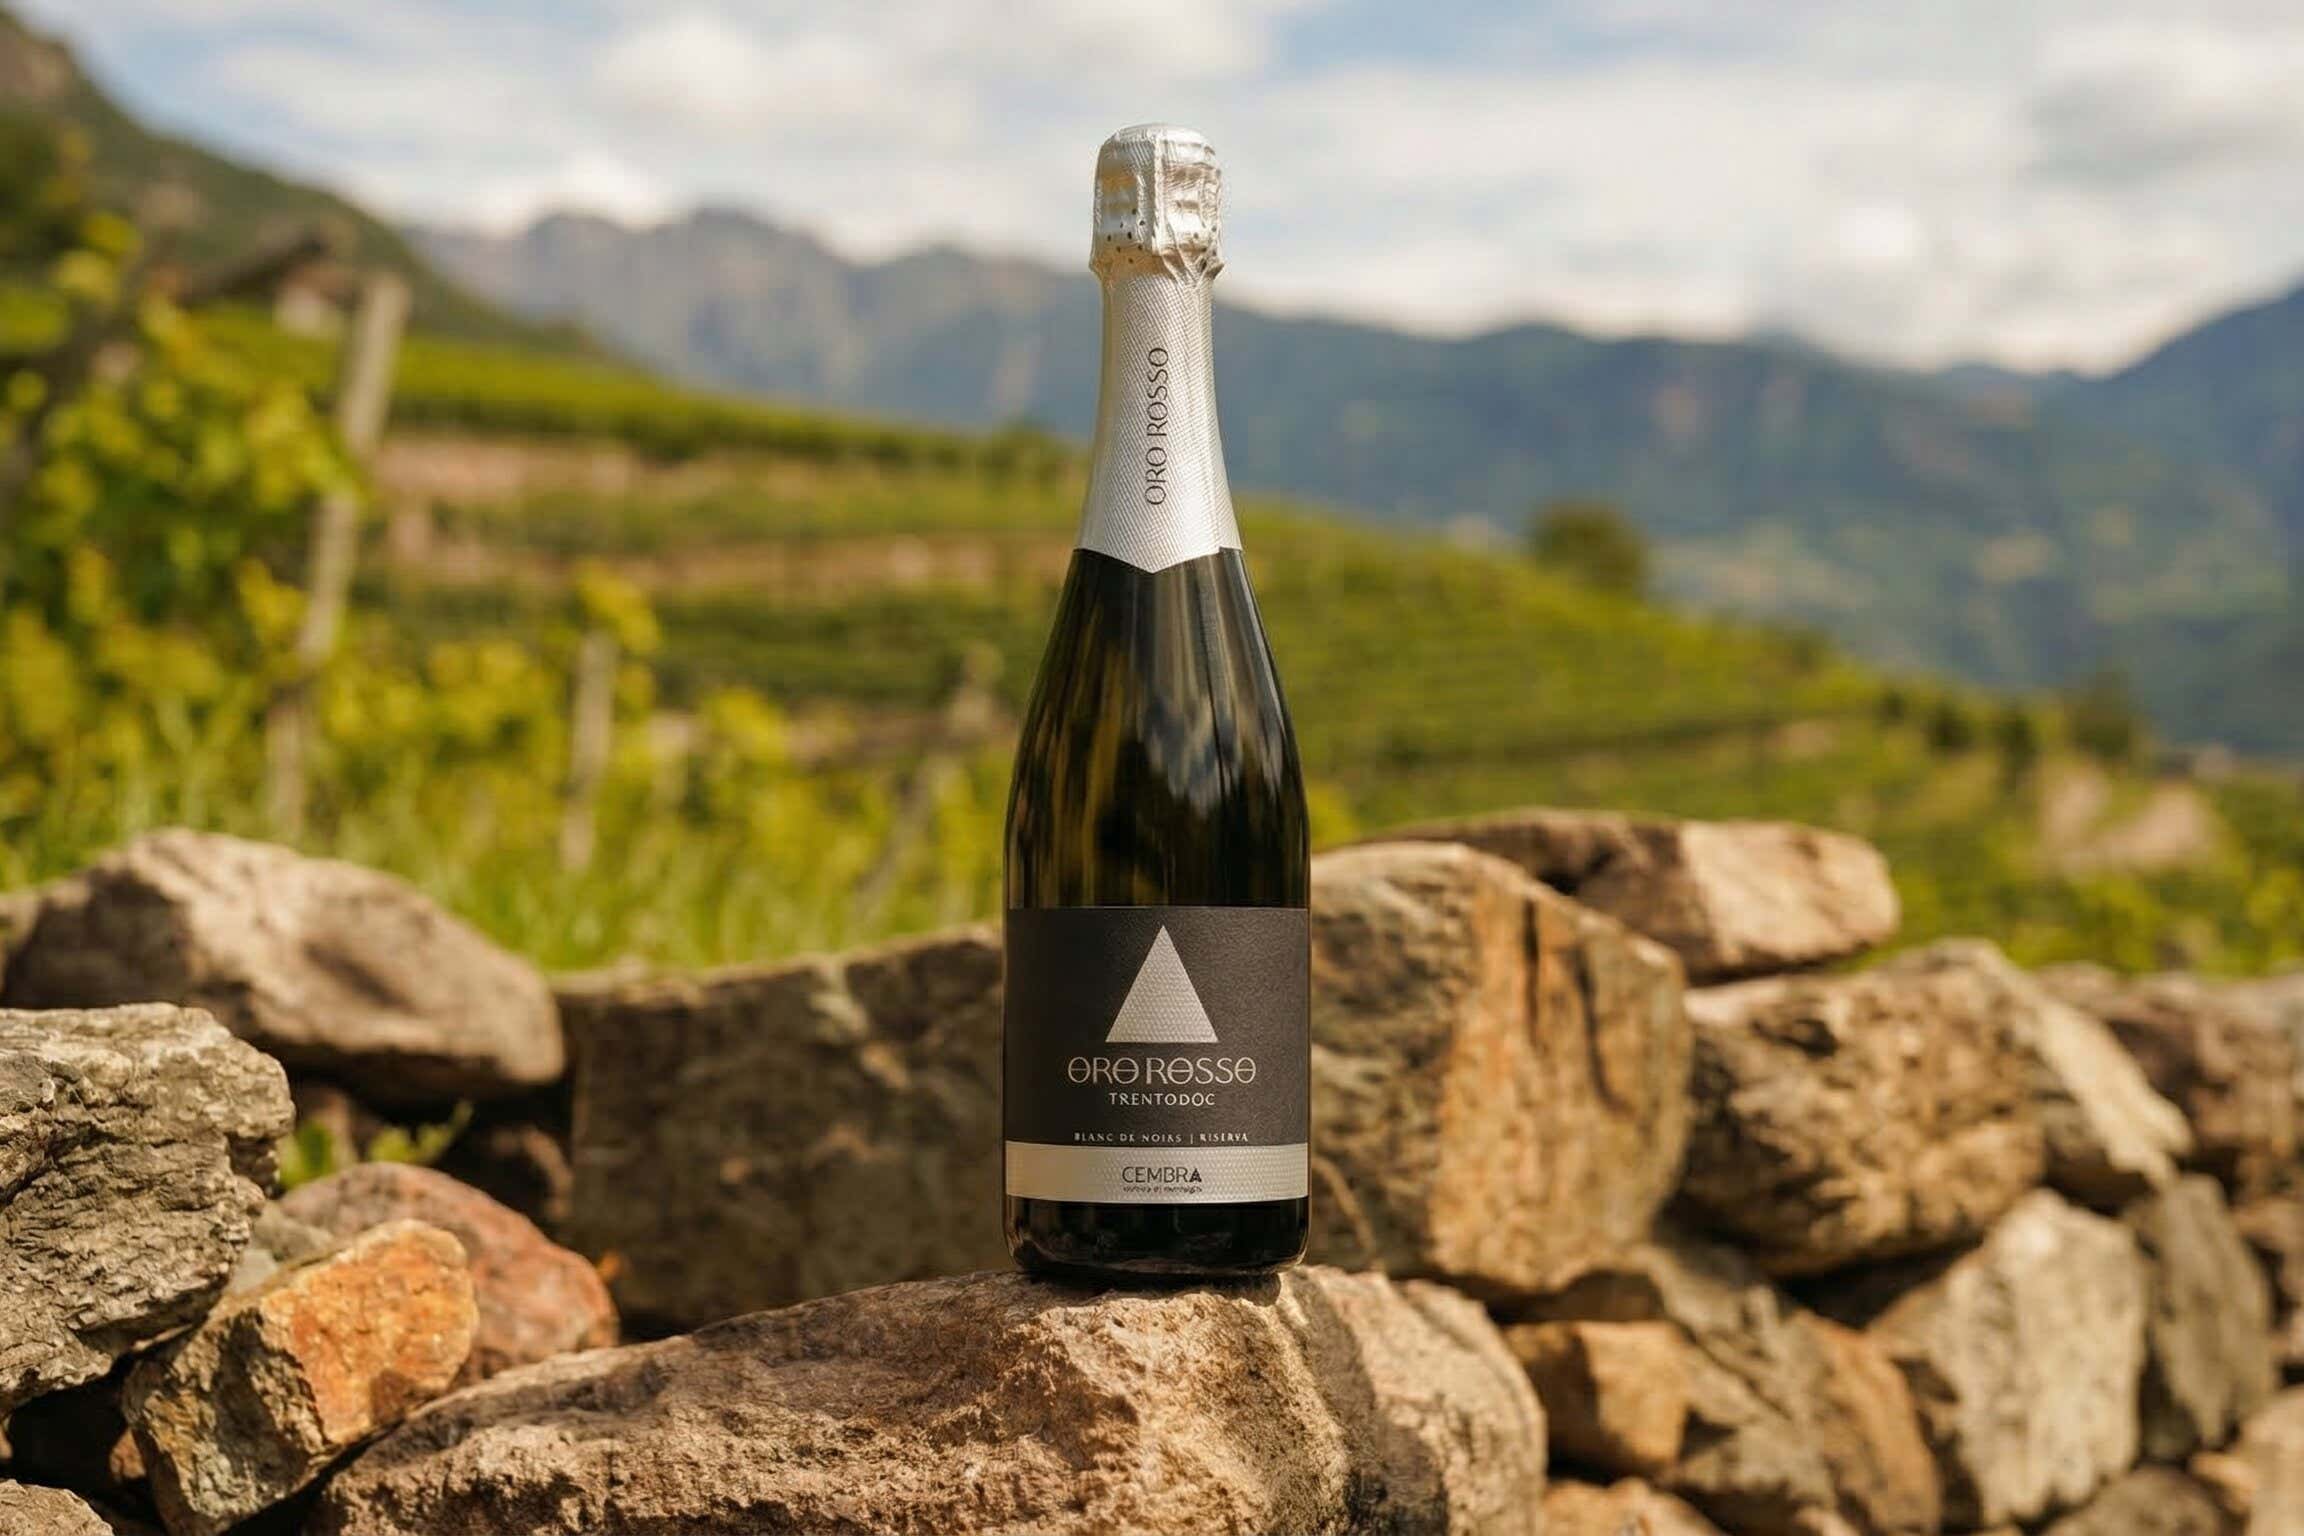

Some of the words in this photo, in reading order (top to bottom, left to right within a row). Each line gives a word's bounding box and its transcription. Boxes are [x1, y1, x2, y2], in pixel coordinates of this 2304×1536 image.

[1146, 347, 1170, 437] ROSSO
[1144, 446, 1168, 505] ORO
[1067, 1056, 1140, 1084] ORO
[1146, 1056, 1257, 1085] ROSSO
[1108, 1092, 1216, 1107] TRENTODOC
[1073, 1132, 1114, 1142] BLANC
[1121, 1166, 1202, 1183] CEMBRA
